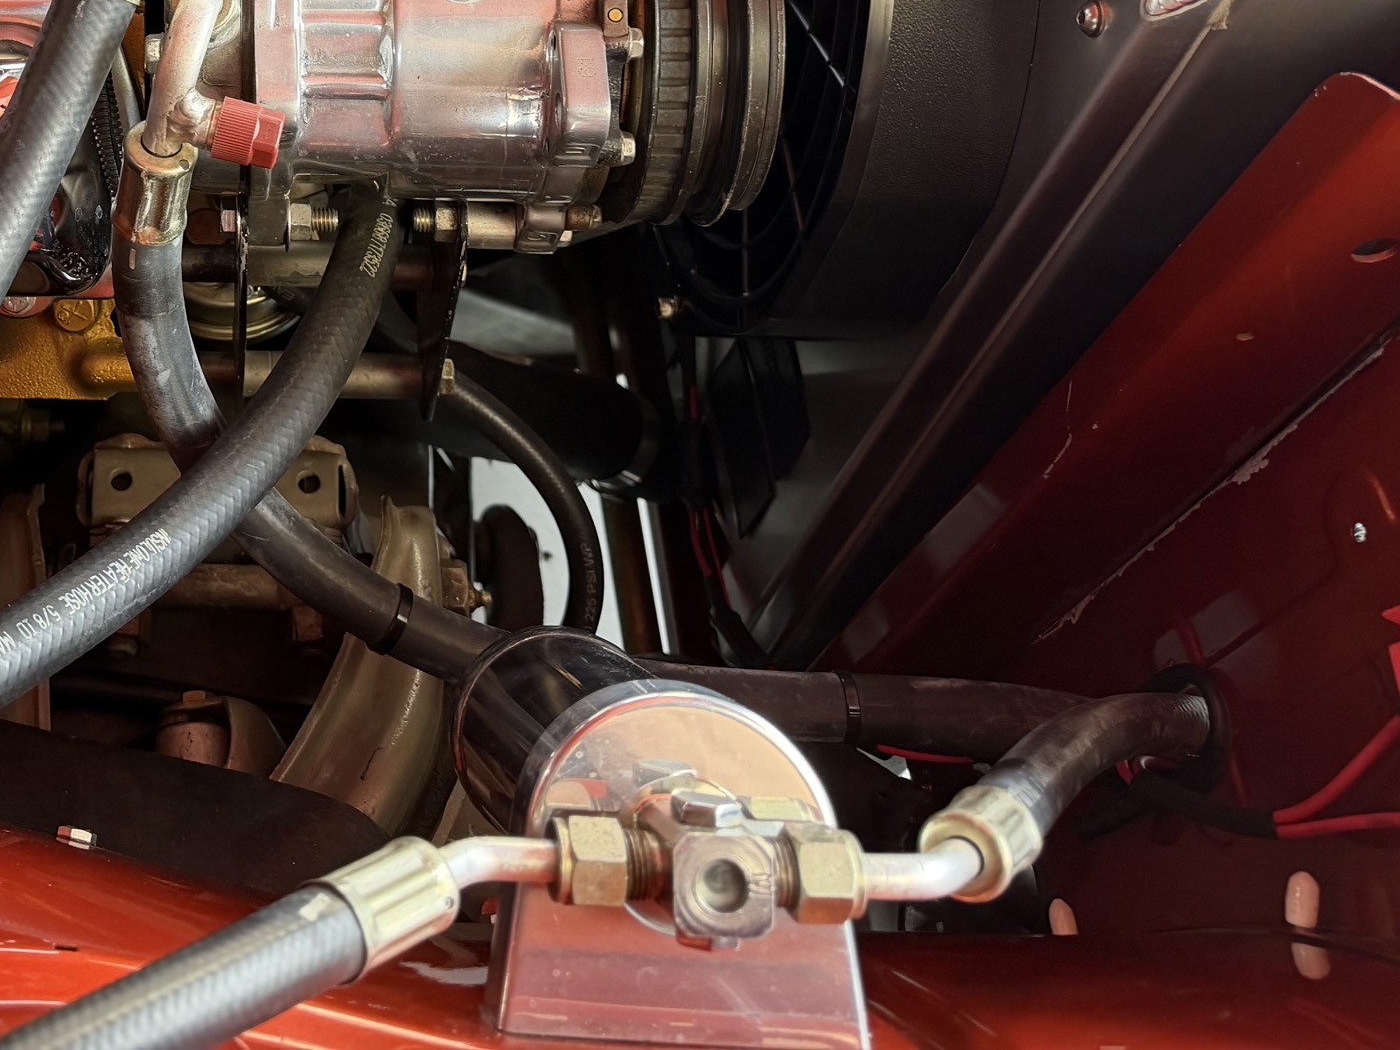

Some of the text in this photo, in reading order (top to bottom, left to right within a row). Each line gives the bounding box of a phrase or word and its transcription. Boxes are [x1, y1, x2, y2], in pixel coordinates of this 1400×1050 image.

[580, 542, 595, 567] WP
[90, 556, 133, 597] HEATER
[585, 569, 598, 594] PSI
[58, 583, 98, 616] HOSE
[32, 604, 63, 630] 5/8
[15, 620, 37, 640] ID
